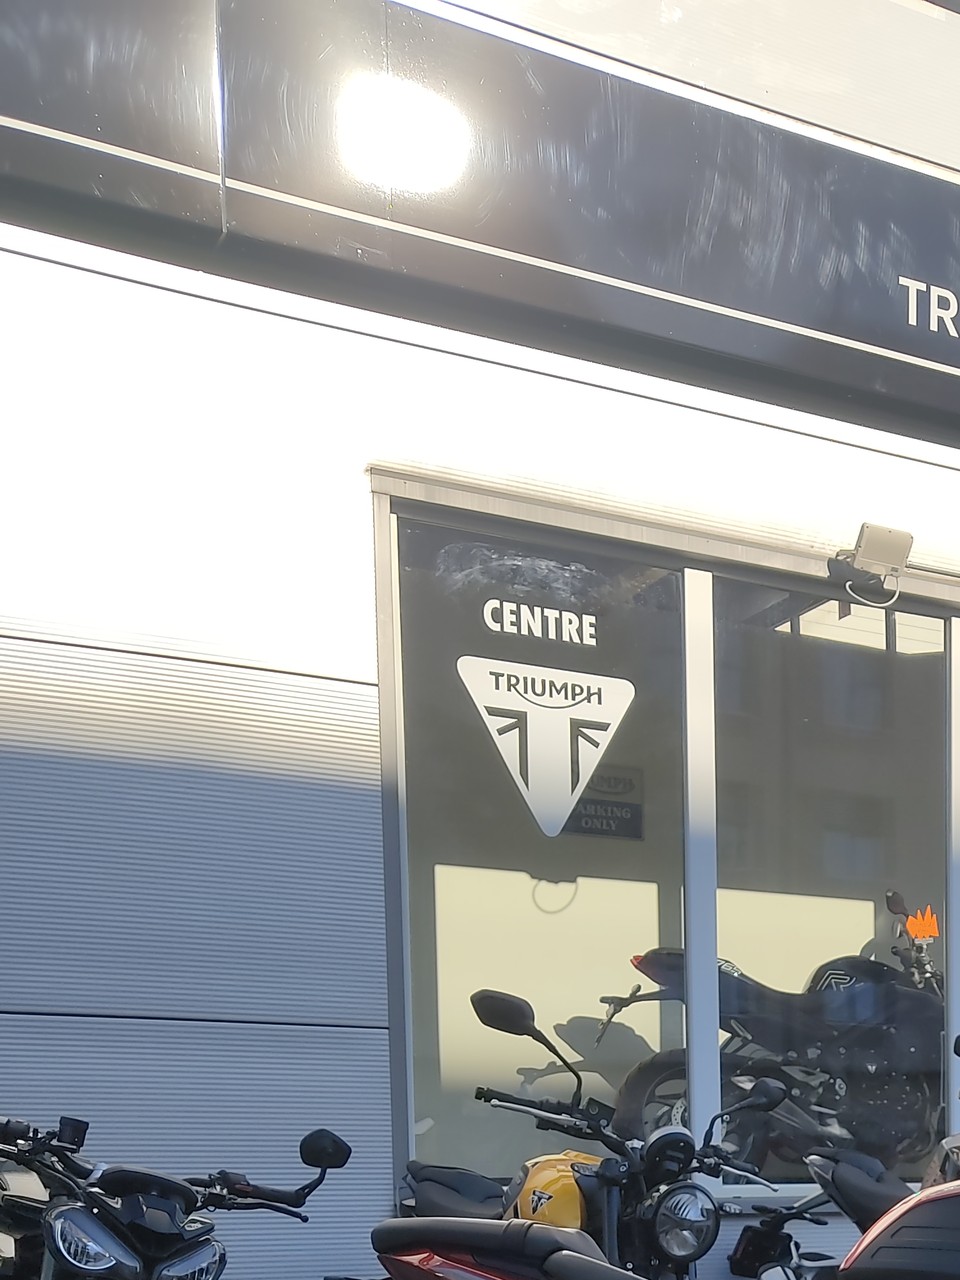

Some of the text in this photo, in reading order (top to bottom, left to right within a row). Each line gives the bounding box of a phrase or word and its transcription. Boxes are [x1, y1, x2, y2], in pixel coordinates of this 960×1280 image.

[482, 598, 597, 647] CENTRE
[489, 670, 603, 707] TRIUMPH
[576, 803, 632, 819] ARKING
[581, 817, 618, 831] ONLY
